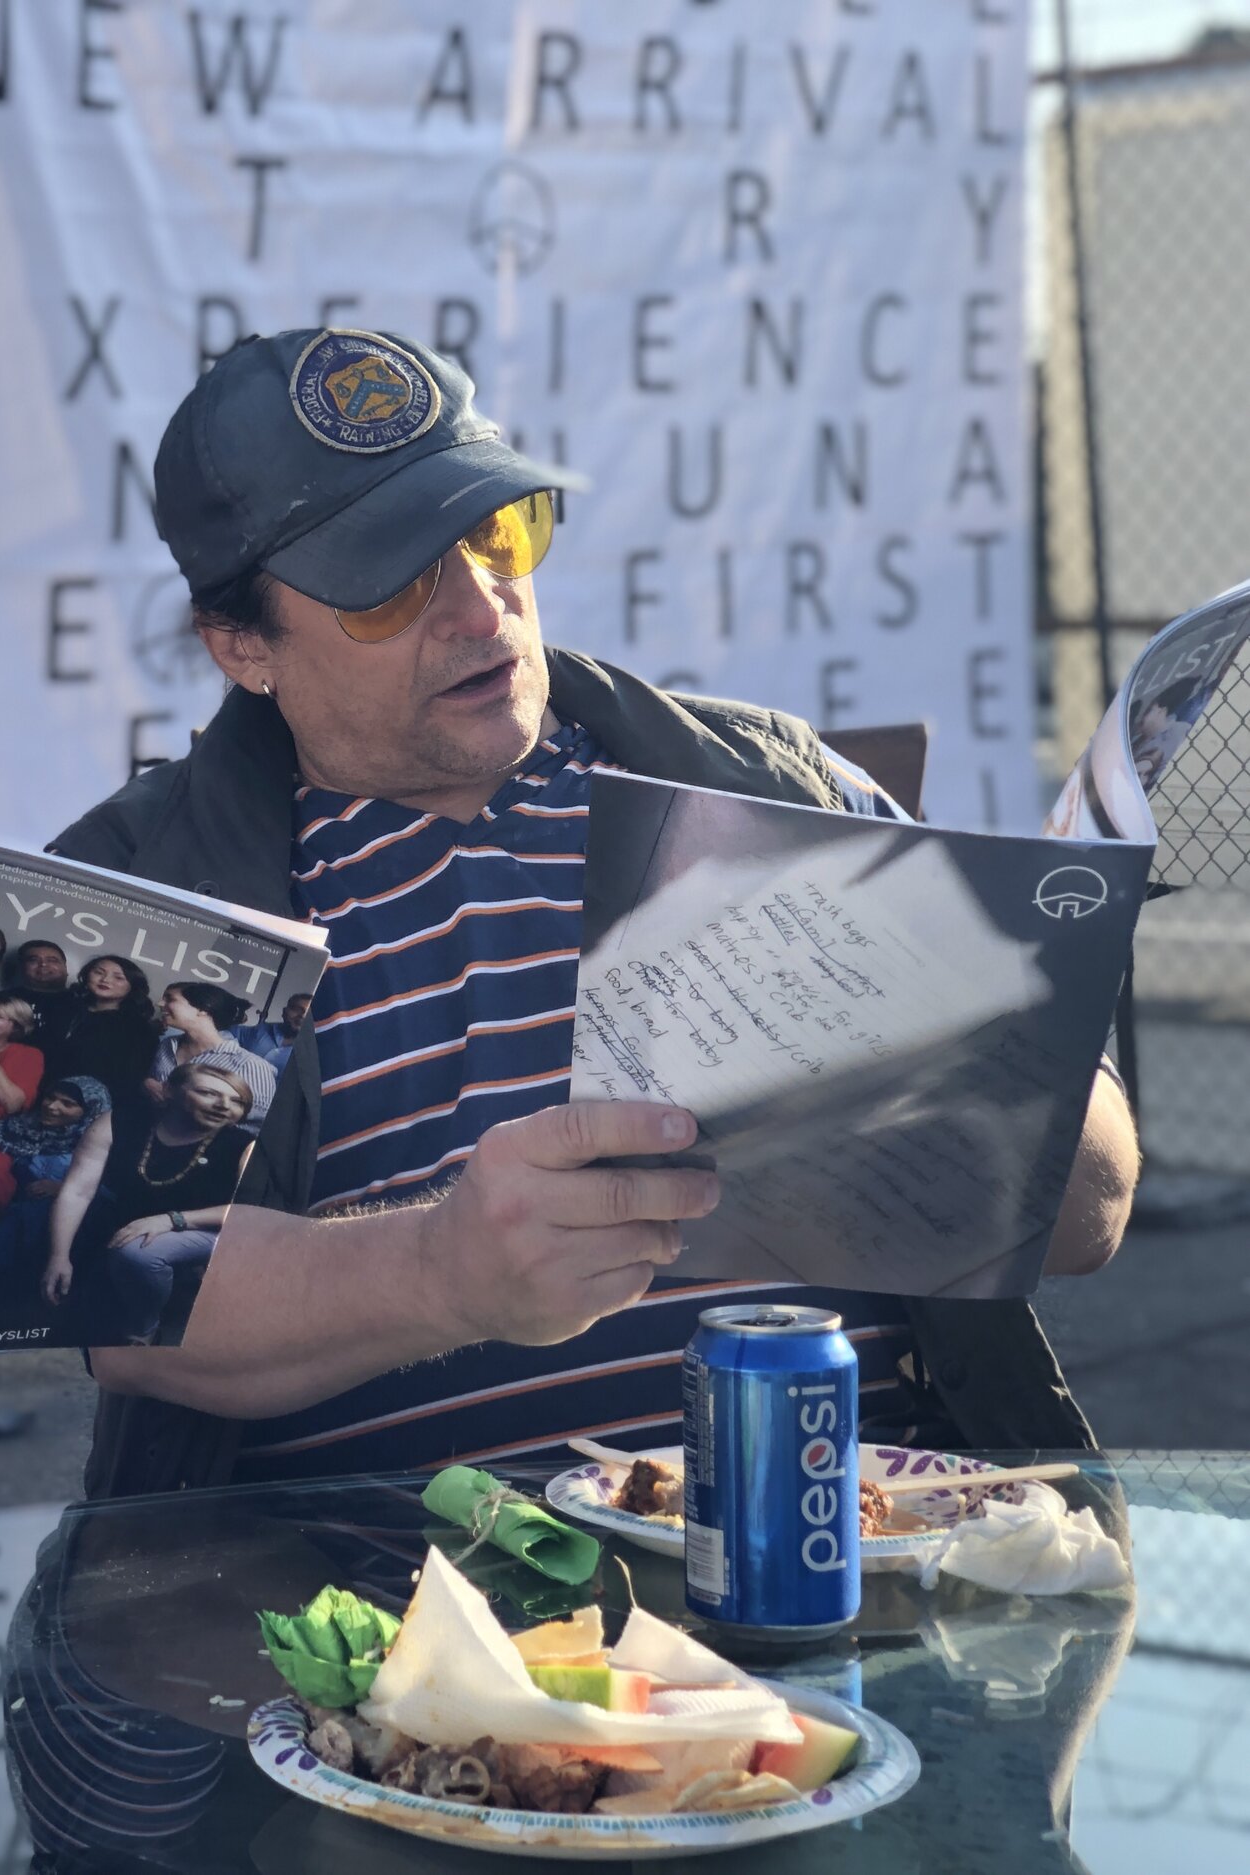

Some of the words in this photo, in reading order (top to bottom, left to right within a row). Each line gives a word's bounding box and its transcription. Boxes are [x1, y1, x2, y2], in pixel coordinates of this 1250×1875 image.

[417, 28, 1012, 147] ARRIVAL
[336, 422, 403, 444] TRAINING
[623, 532, 1003, 645] FIRST
[1143, 632, 1237, 695] LIST
[44, 884, 124, 913] crowdsourcing
[126, 907, 179, 929] solutions.
[55, 876, 68, 887] to
[70, 881, 130, 906] welcoming
[131, 900, 155, 913] new
[157, 908, 192, 925] arrival
[193, 917, 237, 940] families
[238, 935, 259, 948] into
[262, 944, 281, 956] our
[803, 880, 844, 921] trash
[841, 920, 877, 948] bags
[129, 927, 278, 995] LIST
[686, 982, 703, 1001] for
[787, 1384, 847, 1572] pepsi
